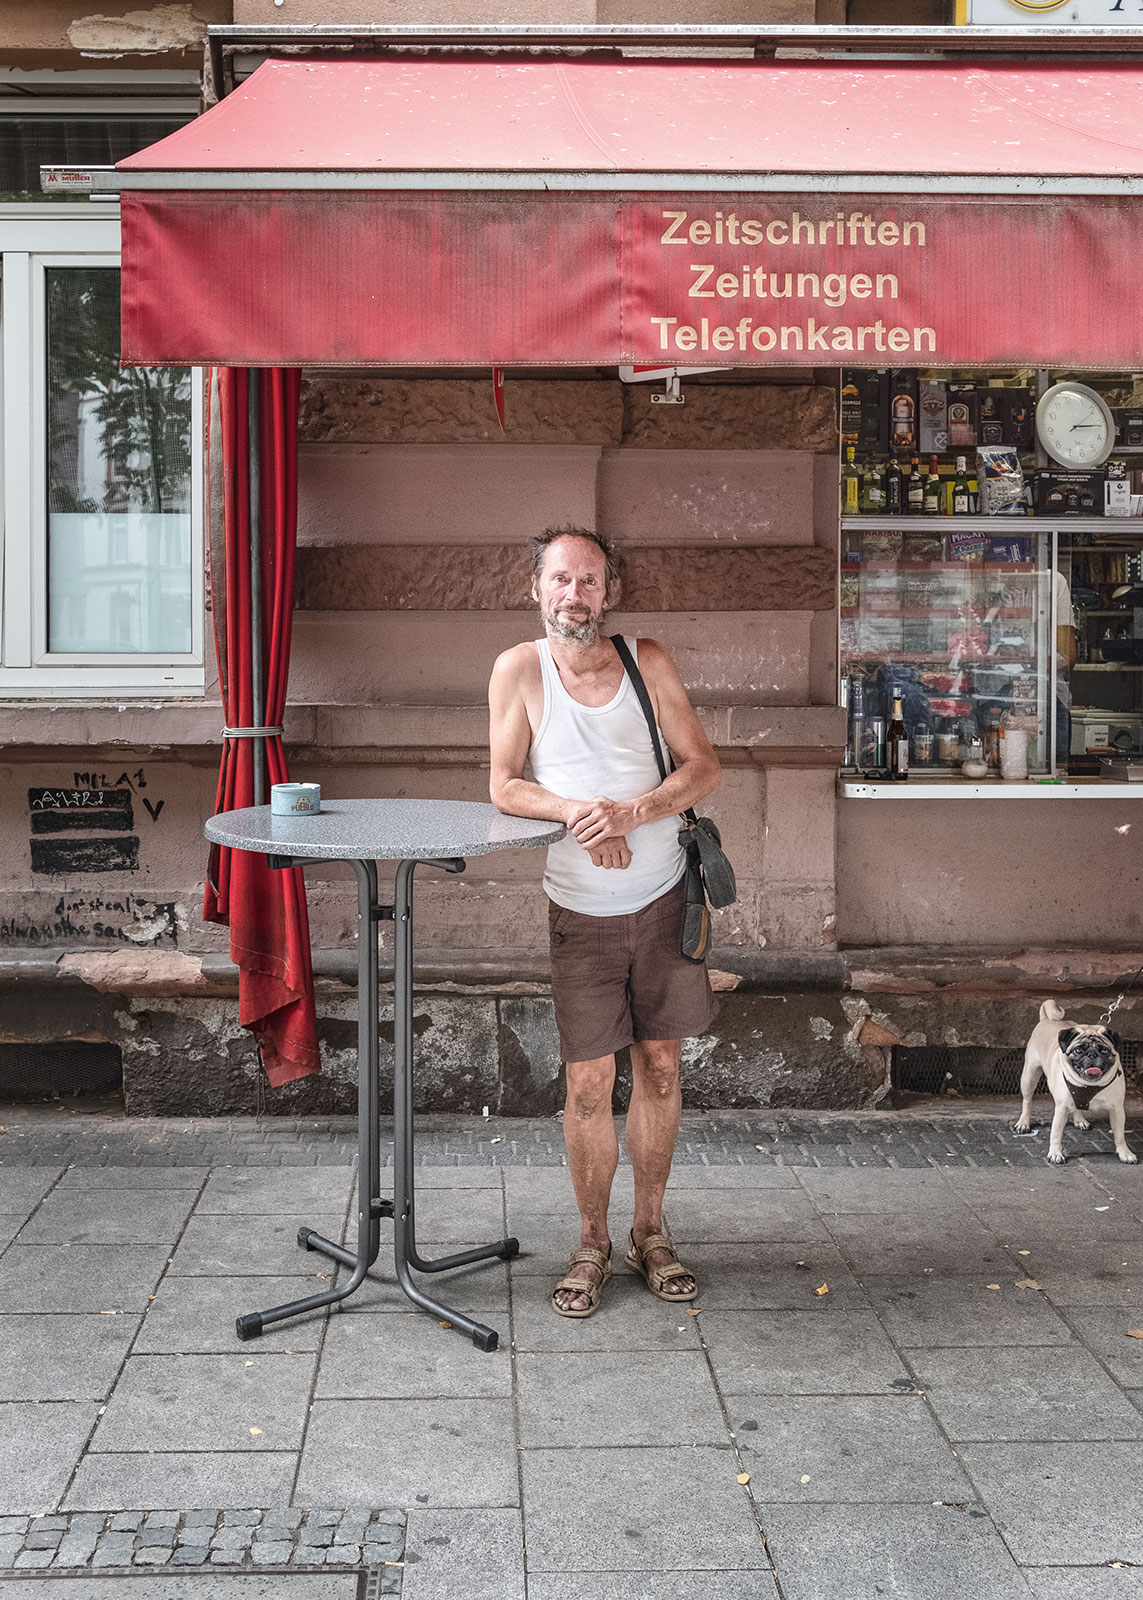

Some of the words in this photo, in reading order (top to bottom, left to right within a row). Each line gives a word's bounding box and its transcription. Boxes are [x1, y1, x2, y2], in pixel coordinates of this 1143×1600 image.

[660, 211, 926, 246] Zeitschriften
[688, 264, 899, 307] Zeitungen
[650, 317, 937, 352] Telefonkarten
